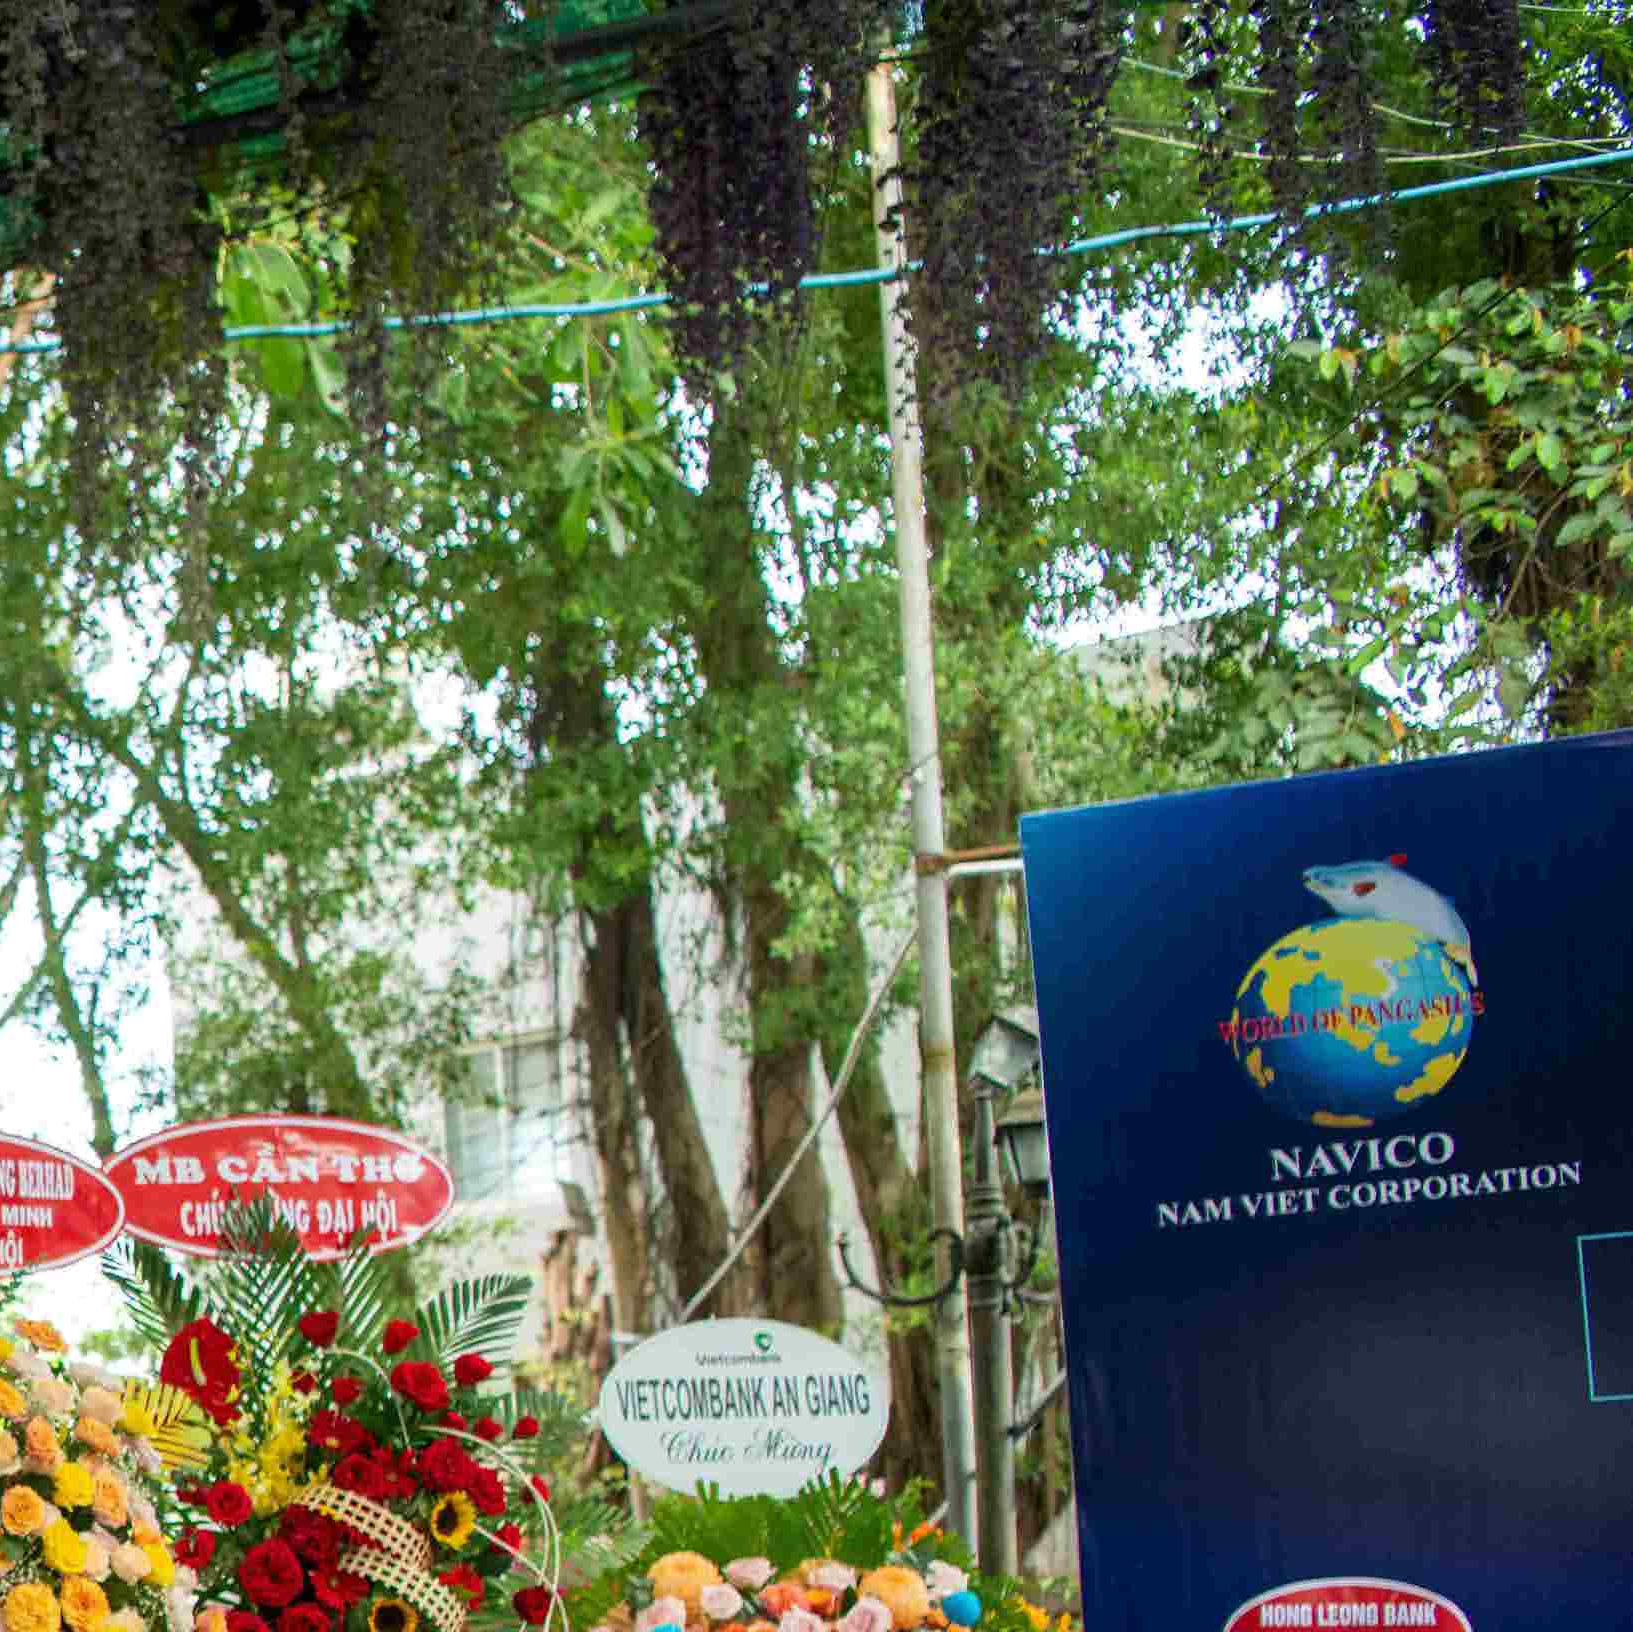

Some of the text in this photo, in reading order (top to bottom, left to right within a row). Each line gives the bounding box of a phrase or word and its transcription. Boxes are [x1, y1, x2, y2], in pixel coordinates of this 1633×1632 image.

[1216, 1012, 1307, 1042] WORLD
[1312, 1007, 1344, 1031] OF
[132, 1143, 426, 1185] MB CẦN THƠ
[1269, 1132, 1455, 1182] NAVICO
[0, 1203, 53, 1228] MINH
[1157, 1161, 1583, 1229] NAM VIET CORPORATION
[615, 1373, 871, 1422] VIETCOMBANK AN GIANG
[1260, 1602, 1436, 1627] HONG LEONG BANK
